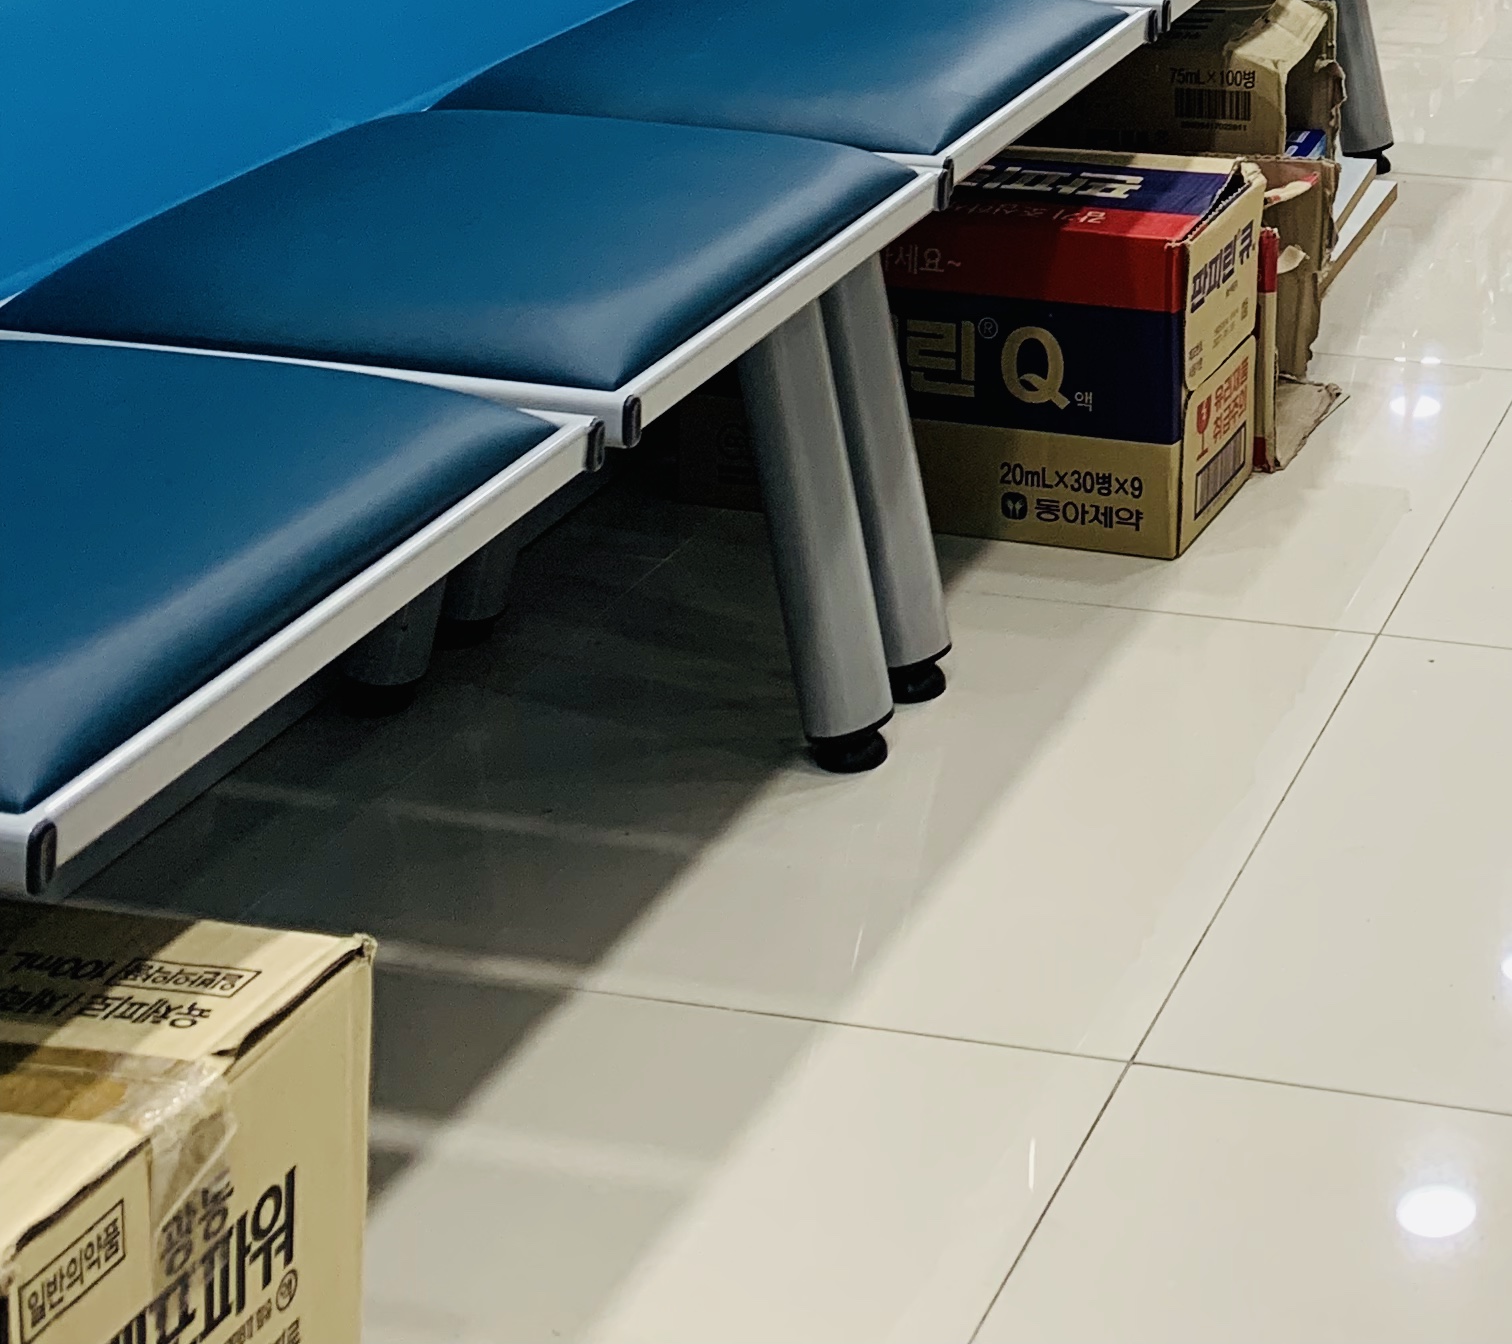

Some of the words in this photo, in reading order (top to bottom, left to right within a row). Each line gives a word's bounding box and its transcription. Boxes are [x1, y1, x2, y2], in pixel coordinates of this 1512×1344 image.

[1169, 67, 1205, 85] 75mL
[1220, 69, 1256, 89] 100병
[1213, 354, 1249, 410] 유리제품
[1212, 384, 1248, 444] 취급주의
[1035, 498, 1144, 532] 동아제약
[119, 965, 243, 992] 일반의약품
[27, 1215, 122, 1328] 일반의약품
